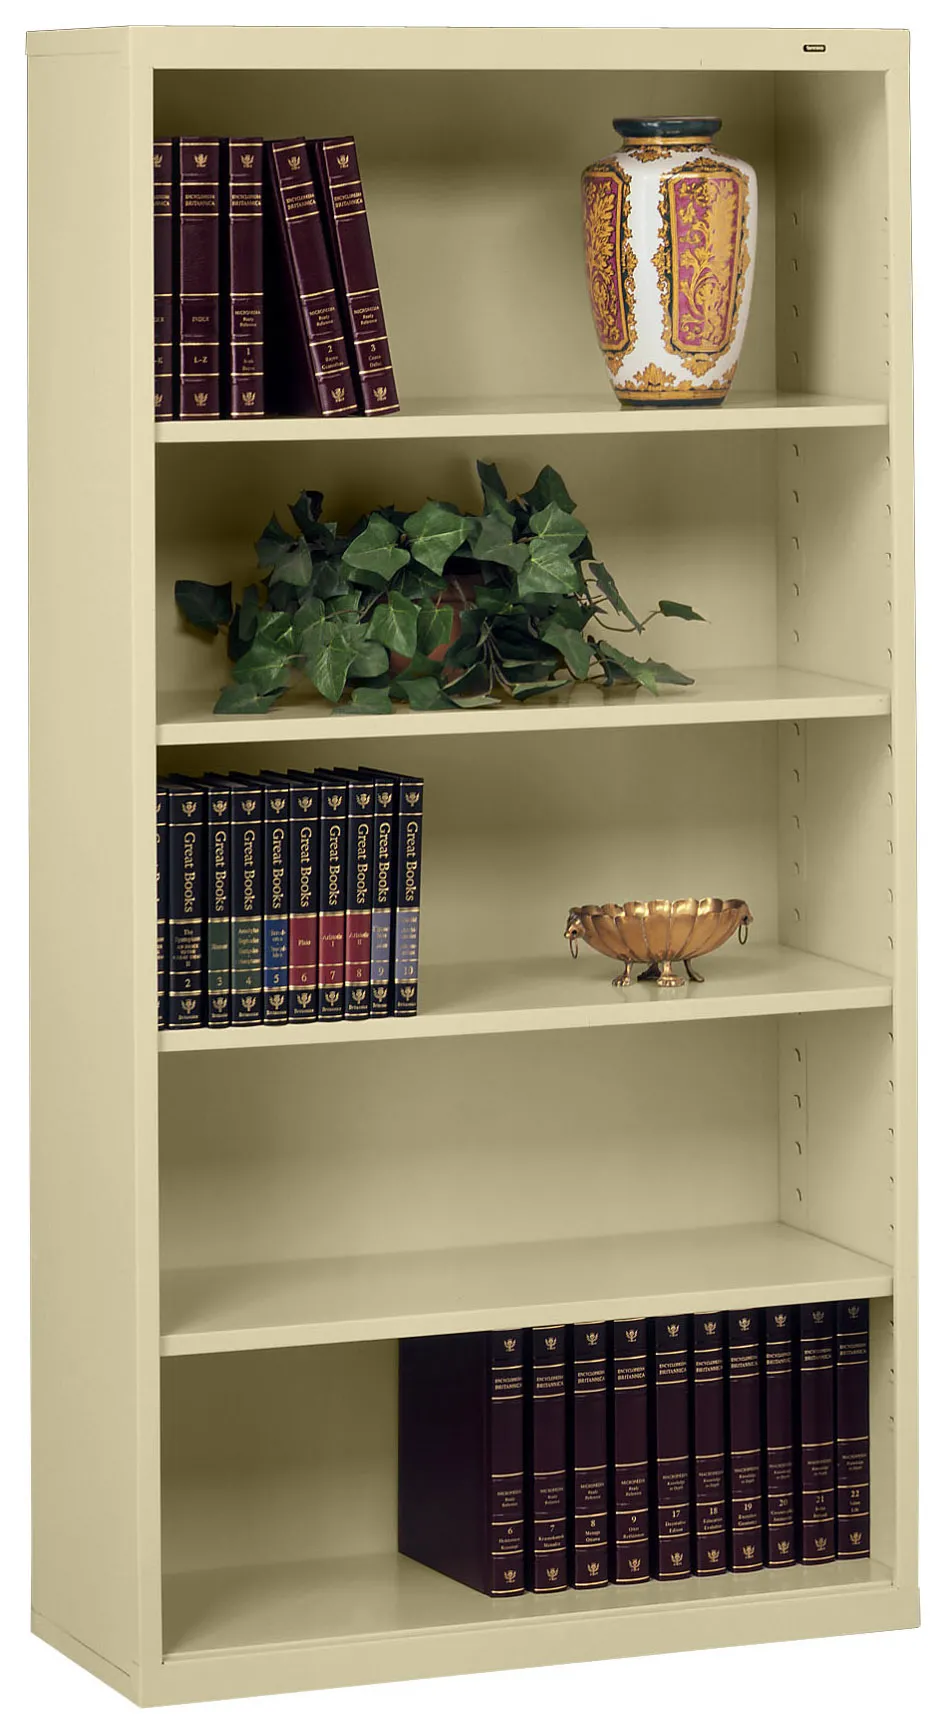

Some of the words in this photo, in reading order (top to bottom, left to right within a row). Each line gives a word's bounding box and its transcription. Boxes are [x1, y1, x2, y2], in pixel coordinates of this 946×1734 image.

[246, 347, 250, 356] 1
[328, 345, 332, 353] 2
[370, 344, 376, 352] 3
[194, 356, 208, 364] L-Z
[300, 826, 312, 863] Great
[330, 826, 340, 862] Great
[358, 824, 368, 860] Great
[380, 822, 390, 858] Great
[406, 821, 418, 858] Great
[184, 832, 196, 869] Great
[215, 830, 226, 868] Great
[244, 830, 255, 866] Great
[272, 828, 284, 865] Great
[329, 865, 340, 906] Books
[357, 863, 368, 904] Books
[378, 862, 390, 902] Books
[406, 861, 418, 901] Books
[215, 871, 226, 912] Books
[244, 870, 255, 911] Books
[272, 868, 284, 909] Books
[300, 866, 312, 907] Books
[184, 872, 196, 912] Books
[330, 970, 336, 980] 7
[356, 969, 362, 978] 8
[378, 966, 384, 976] 9
[404, 966, 413, 976] 10
[217, 976, 222, 986] 3
[246, 976, 252, 984] 4
[274, 974, 279, 984] 5
[301, 972, 307, 982] 6
[185, 978, 191, 988] 2
[850, 1490, 860, 1498] 22
[779, 1499, 788, 1507] 20
[816, 1495, 824, 1504] 21
[710, 1507, 718, 1515] 18
[744, 1502, 752, 1511] 19
[672, 1510, 680, 1518] 17
[632, 1516, 636, 1524] 9
[550, 1524, 555, 1532] 7
